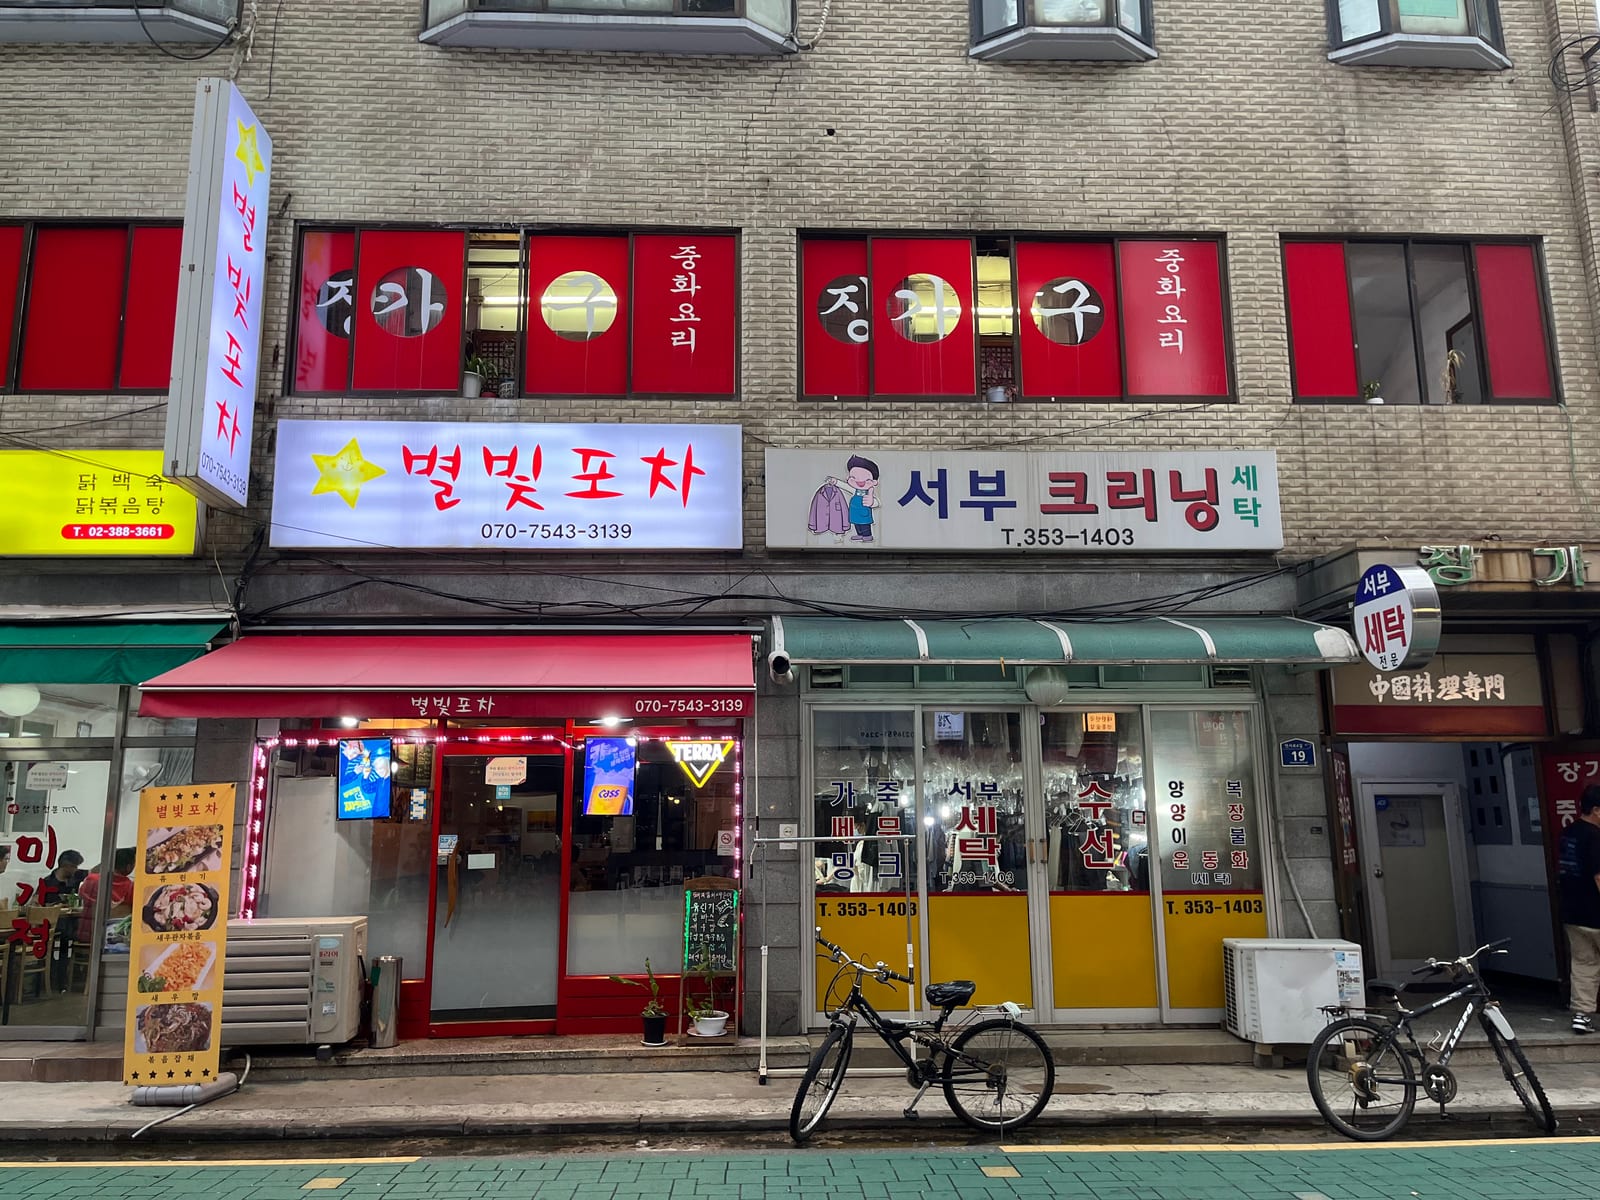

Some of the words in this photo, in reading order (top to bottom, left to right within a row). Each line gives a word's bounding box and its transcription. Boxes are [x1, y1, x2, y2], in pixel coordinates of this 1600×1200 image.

[670, 245, 702, 353] 중화요리
[1154, 248, 1188, 354] 중화요리
[215, 178, 256, 458] 별빛포차
[78, 473, 163, 491] 닭백숙
[201, 452, 247, 496] 070-7543-3139
[402, 443, 706, 512] 별빛포차
[75, 496, 165, 516] 닭볶음탕
[897, 468, 1017, 522] 서부
[1040, 468, 1220, 532] 크리닝
[1231, 465, 1263, 528] 세탁
[73, 525, 84, 538] T.
[88, 525, 163, 538] 02-388-3661
[481, 523, 633, 540] 070-7543-3139
[1001, 528, 1135, 548] T.353-1403
[1417, 544, 1592, 587] 장가
[1363, 570, 1392, 596] 서부
[1363, 604, 1407, 654] 세탁
[1379, 652, 1398, 669] 전문
[411, 695, 496, 716] 별빛포차
[635, 699, 743, 713] 070-7543-3139
[671, 743, 726, 763] TERRA
[1291, 750, 1306, 762] 19
[830, 781, 900, 809] 가죽
[948, 781, 1003, 803] 서부
[156, 802, 218, 819] 별빛포차
[955, 806, 1001, 868] 세탁
[1077, 781, 1115, 870] 수선
[832, 852, 903, 881] 밍크
[837, 902, 918, 917] 353-1403
[1184, 899, 1263, 914] 353-1403
